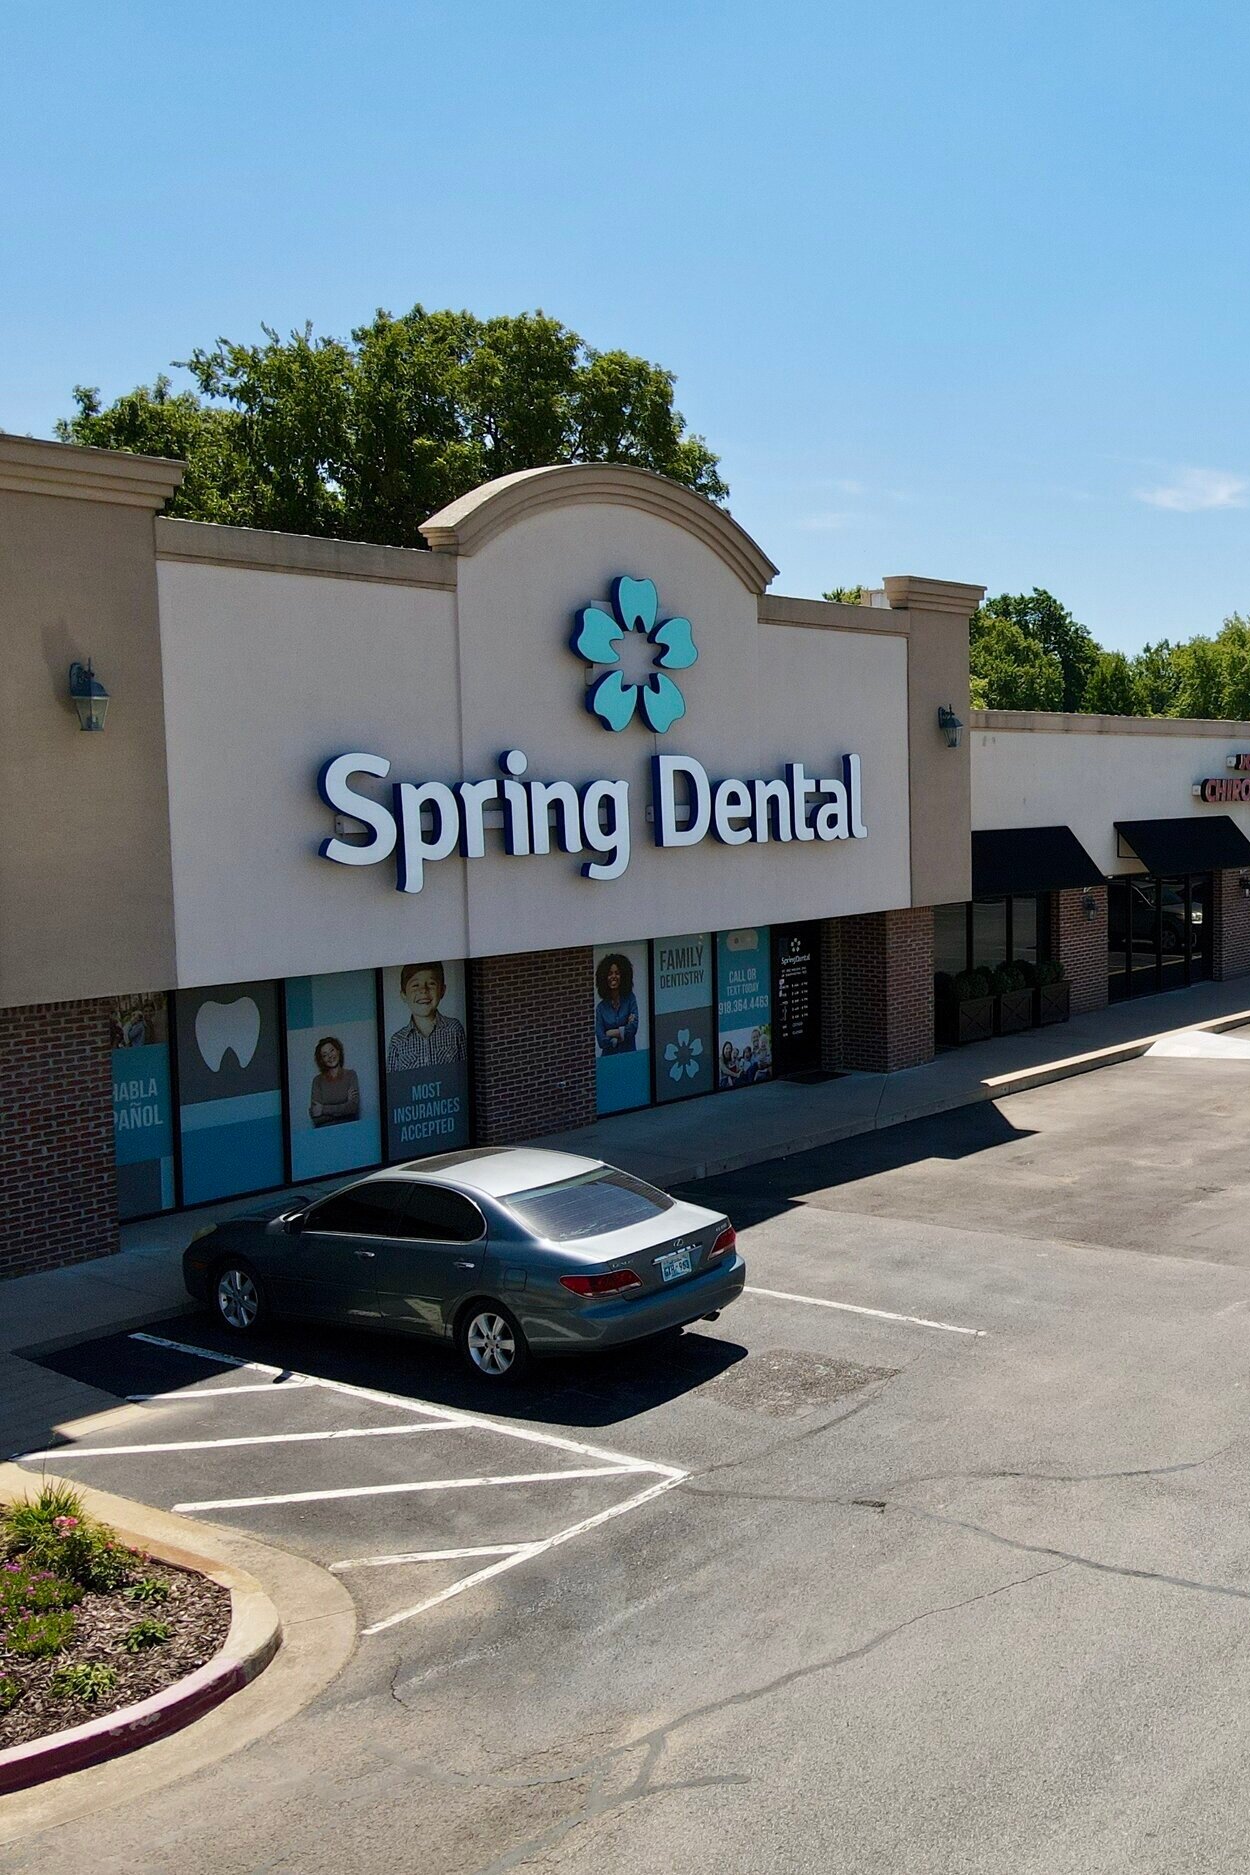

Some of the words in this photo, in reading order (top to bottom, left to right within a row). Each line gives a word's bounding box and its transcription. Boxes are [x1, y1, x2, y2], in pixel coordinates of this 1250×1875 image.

[317, 750, 629, 894] Spring
[651, 753, 868, 847] Dental
[660, 946, 704, 971] FAMILY
[660, 970, 705, 989] DENTISTRY
[729, 970, 746, 983] CALL
[747, 968, 757, 980] OR
[727, 985, 741, 996] TEXT
[742, 982, 760, 993] TODAY
[412, 1081, 442, 1101] MOST
[394, 1097, 460, 1124] INSURANCES
[401, 1117, 455, 1142] ACCEPTED
